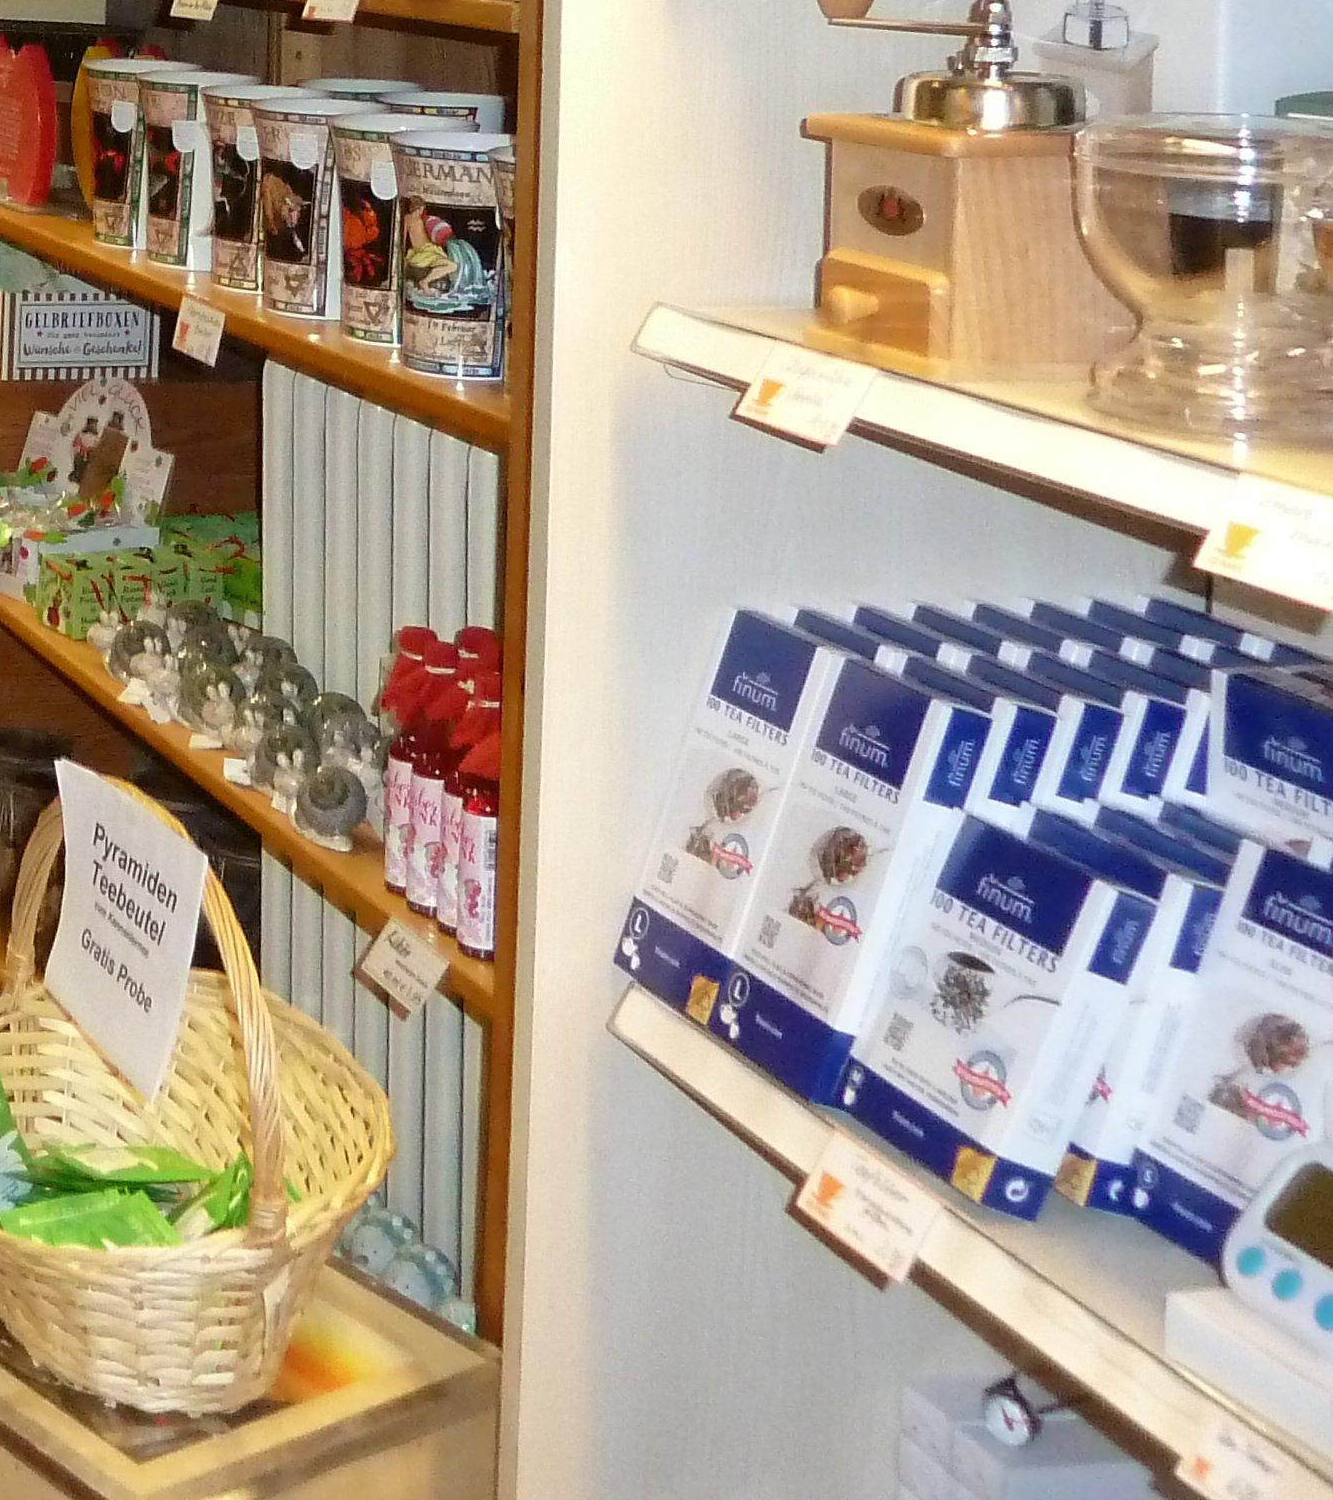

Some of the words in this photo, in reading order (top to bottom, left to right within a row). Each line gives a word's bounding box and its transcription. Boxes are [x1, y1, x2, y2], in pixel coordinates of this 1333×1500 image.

[731, 673, 778, 713] finum
[724, 704, 744, 724] TEA
[745, 715, 789, 747] FILTERS
[838, 724, 888, 769] finum
[830, 758, 851, 780] TEA
[853, 770, 901, 805] FILTERS
[1255, 770, 1287, 800] TEA
[93, 822, 179, 914] Pyramiden
[92, 860, 167, 947] Teebeutel
[975, 874, 1033, 925] finum
[957, 902, 988, 936] TEA
[991, 924, 1062, 975] FILTERS
[81, 928, 116, 976] Gratis
[117, 963, 153, 1015] Probe
